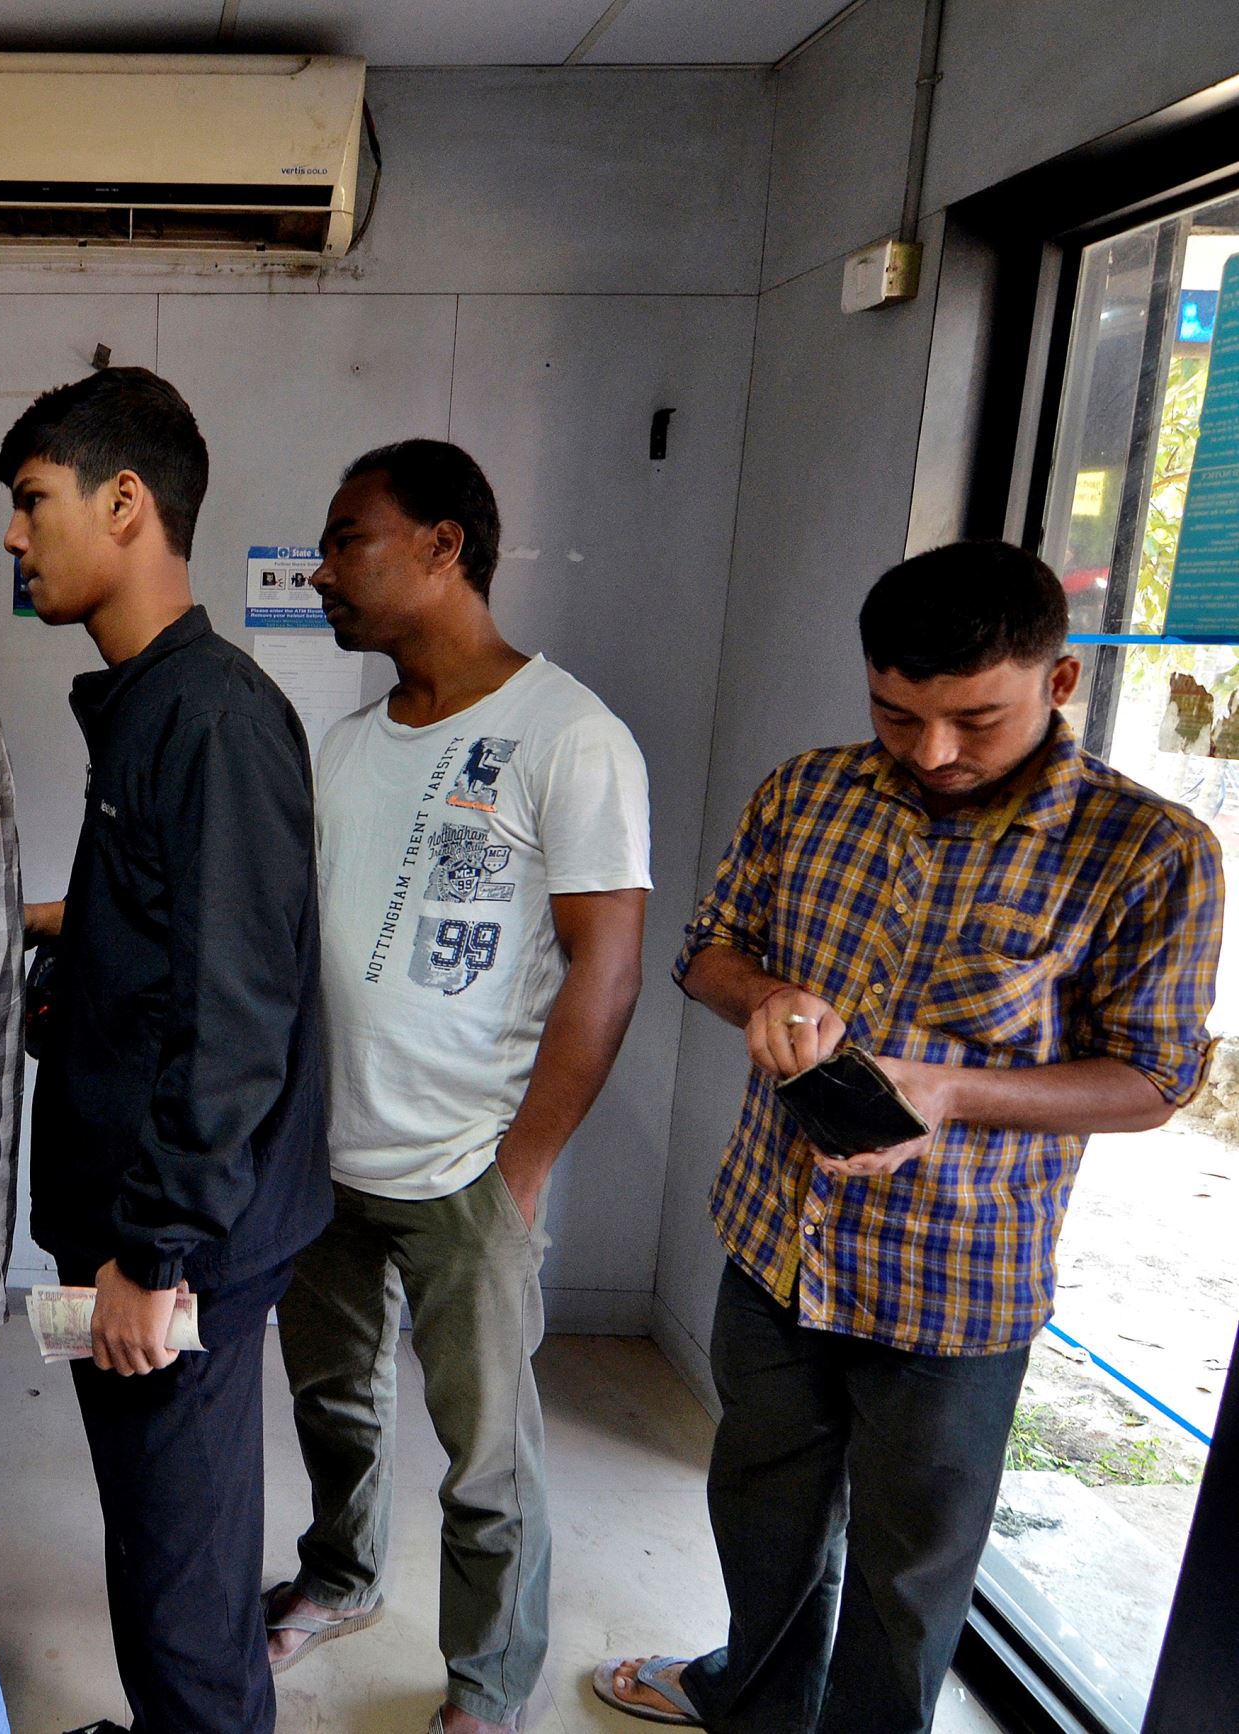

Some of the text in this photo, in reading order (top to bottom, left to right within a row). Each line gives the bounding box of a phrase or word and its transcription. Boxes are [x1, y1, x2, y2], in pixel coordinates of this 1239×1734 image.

[291, 548, 312, 557] State
[488, 849, 507, 858] MCJ
[364, 736, 465, 984] NOTTINGHAM TRENT VARSITY
[455, 869, 476, 878] MCJ
[457, 879, 472, 890] 99
[430, 918, 502, 971] 99
